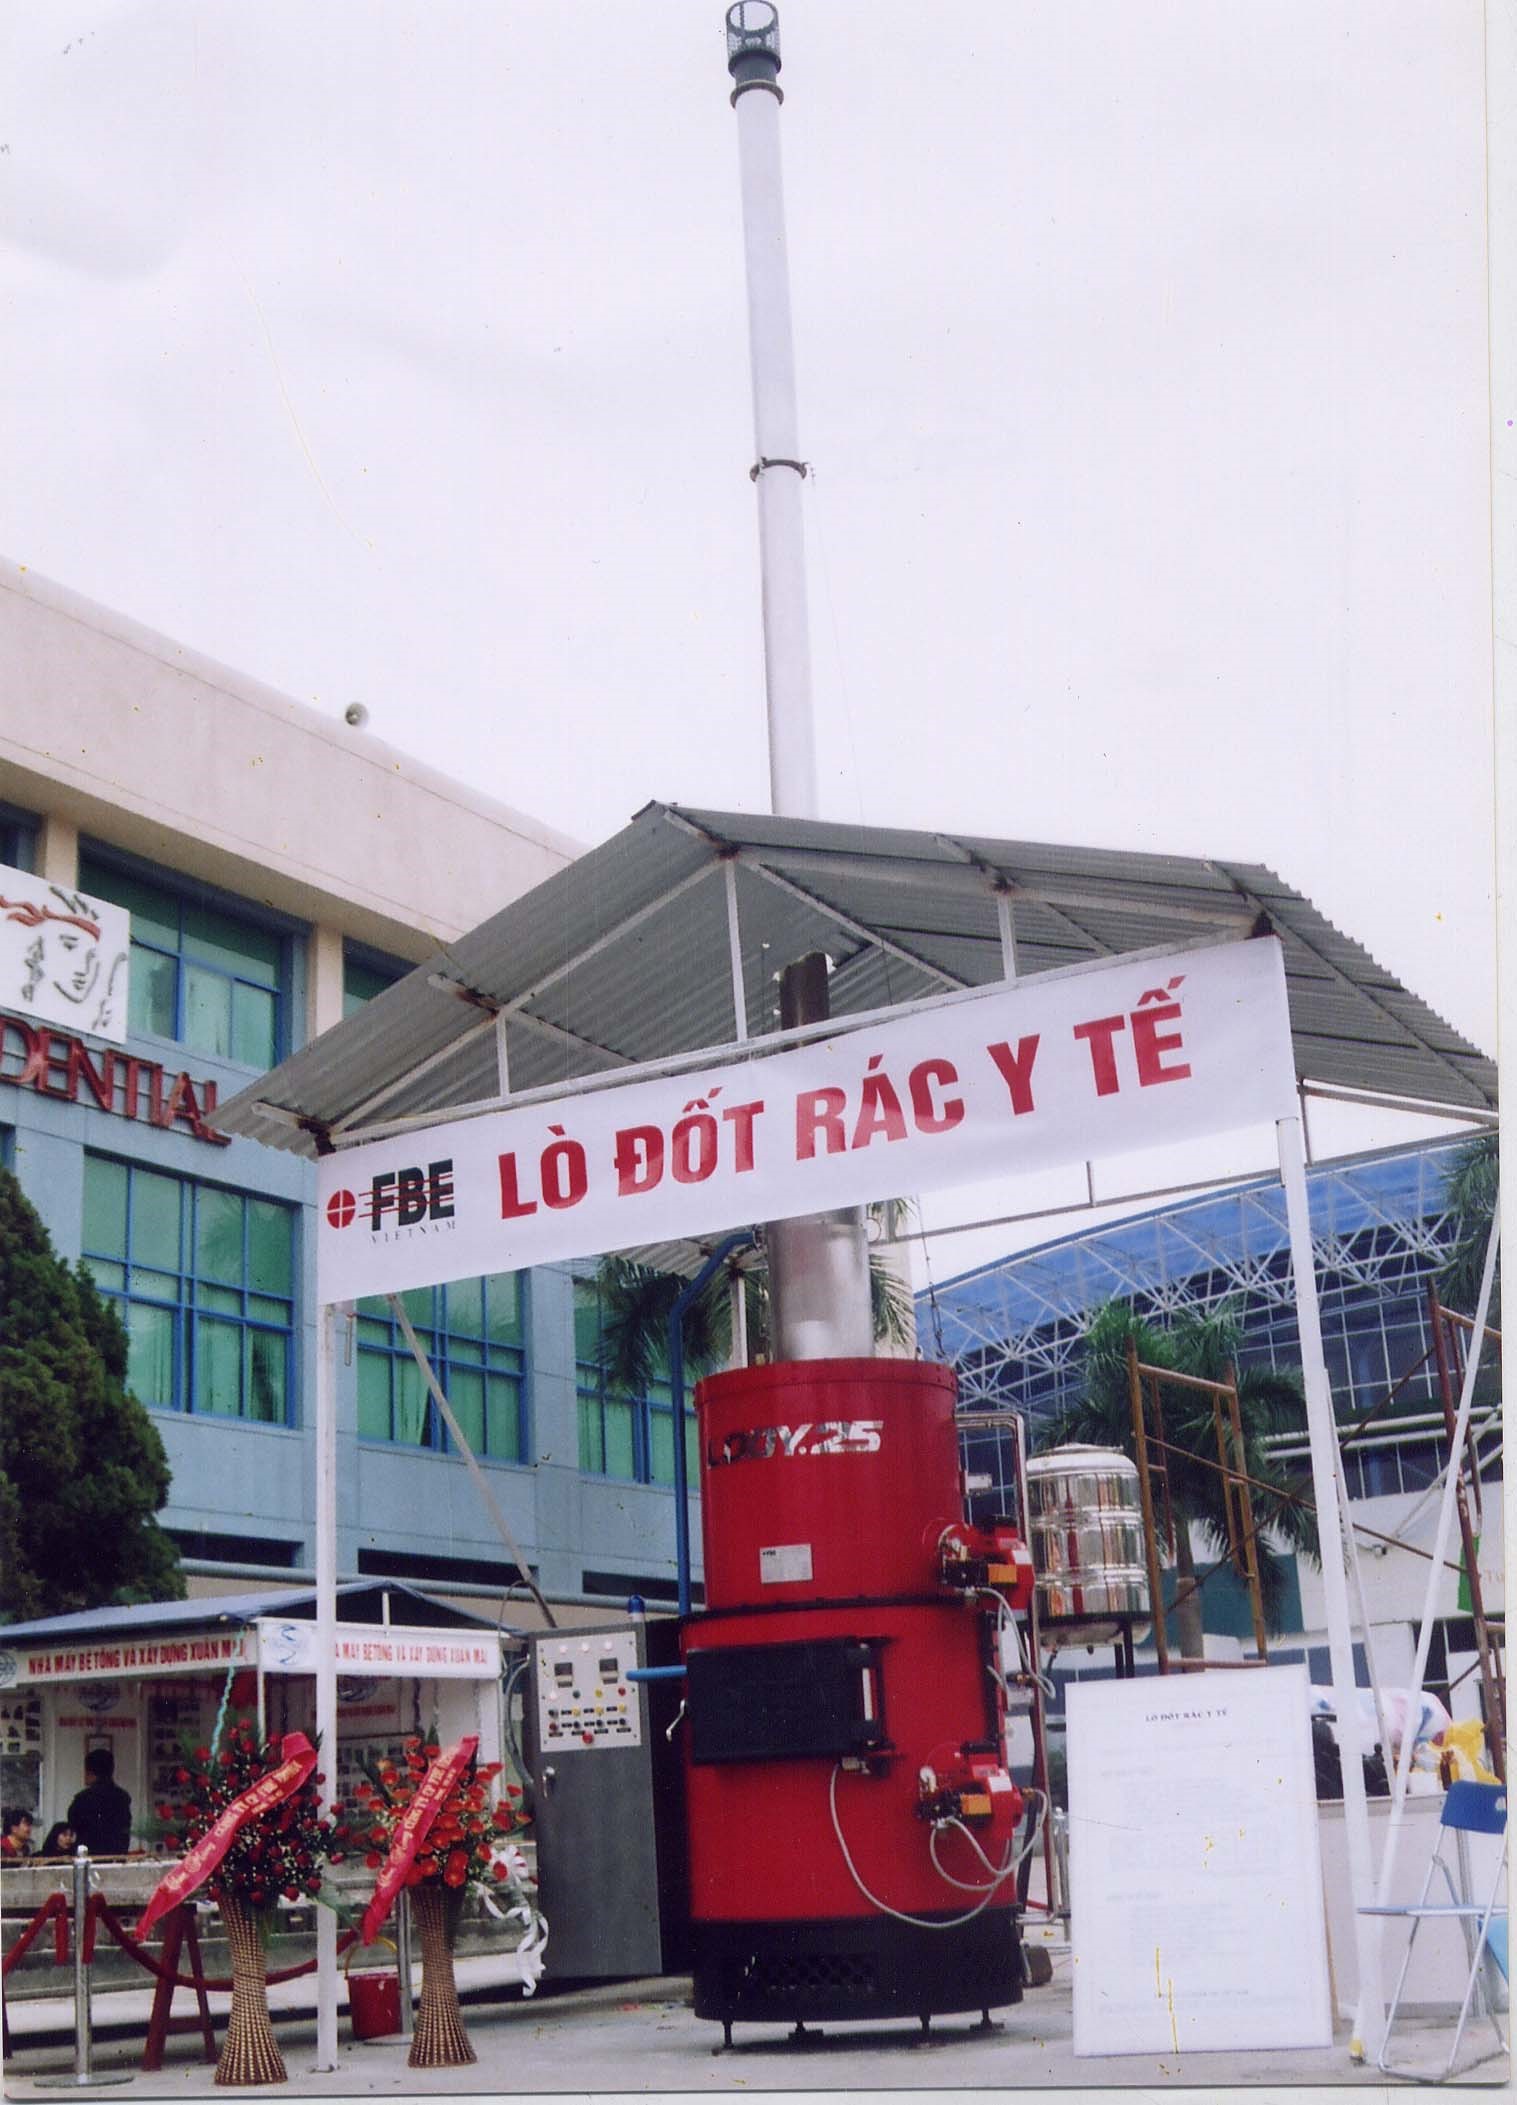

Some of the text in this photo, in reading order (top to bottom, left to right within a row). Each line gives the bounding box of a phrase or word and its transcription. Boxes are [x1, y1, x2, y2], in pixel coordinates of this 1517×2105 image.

[498, 975, 1191, 1219] LÒ ĐỐT RÁC Y TẾ
[371, 1159, 454, 1231] FBE
[371, 1219, 456, 1244] VIETNAM
